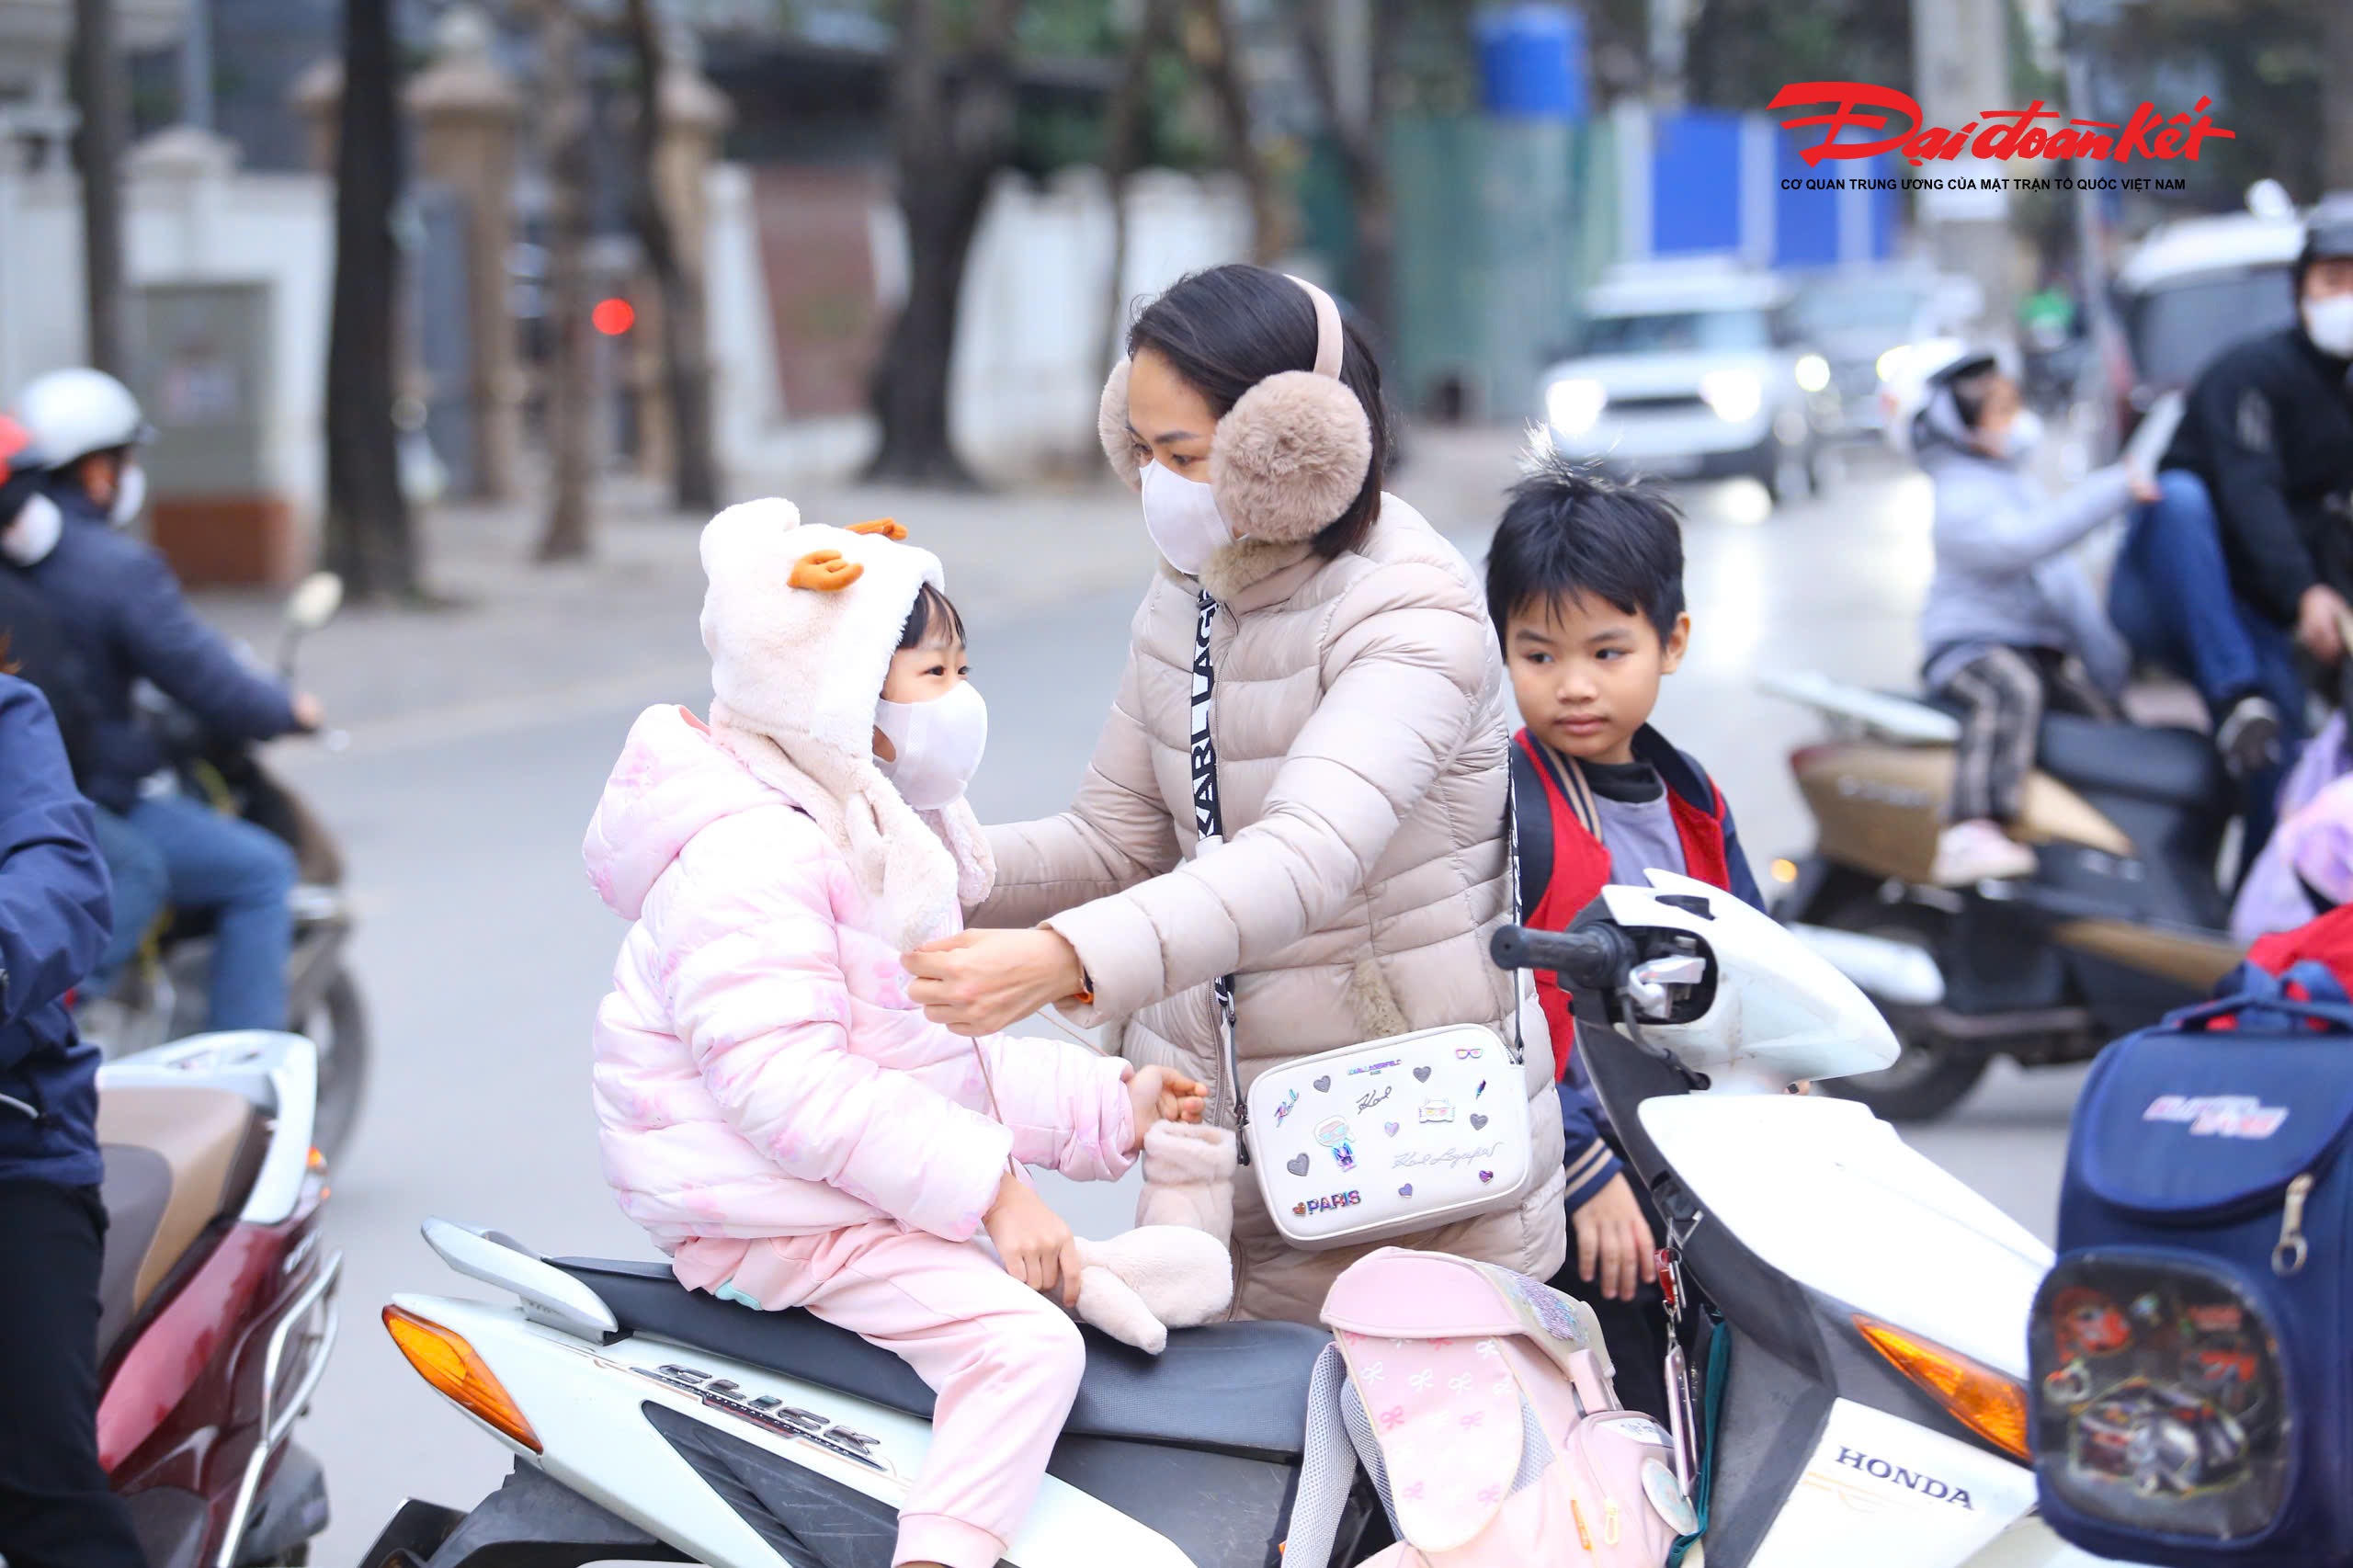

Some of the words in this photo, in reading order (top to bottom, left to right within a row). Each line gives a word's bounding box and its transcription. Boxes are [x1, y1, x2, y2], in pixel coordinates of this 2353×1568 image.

[1306, 1189, 1361, 1215] PARIS
[654, 1363, 882, 1456] CLICK
[1835, 1445, 1975, 1511] HONDA
